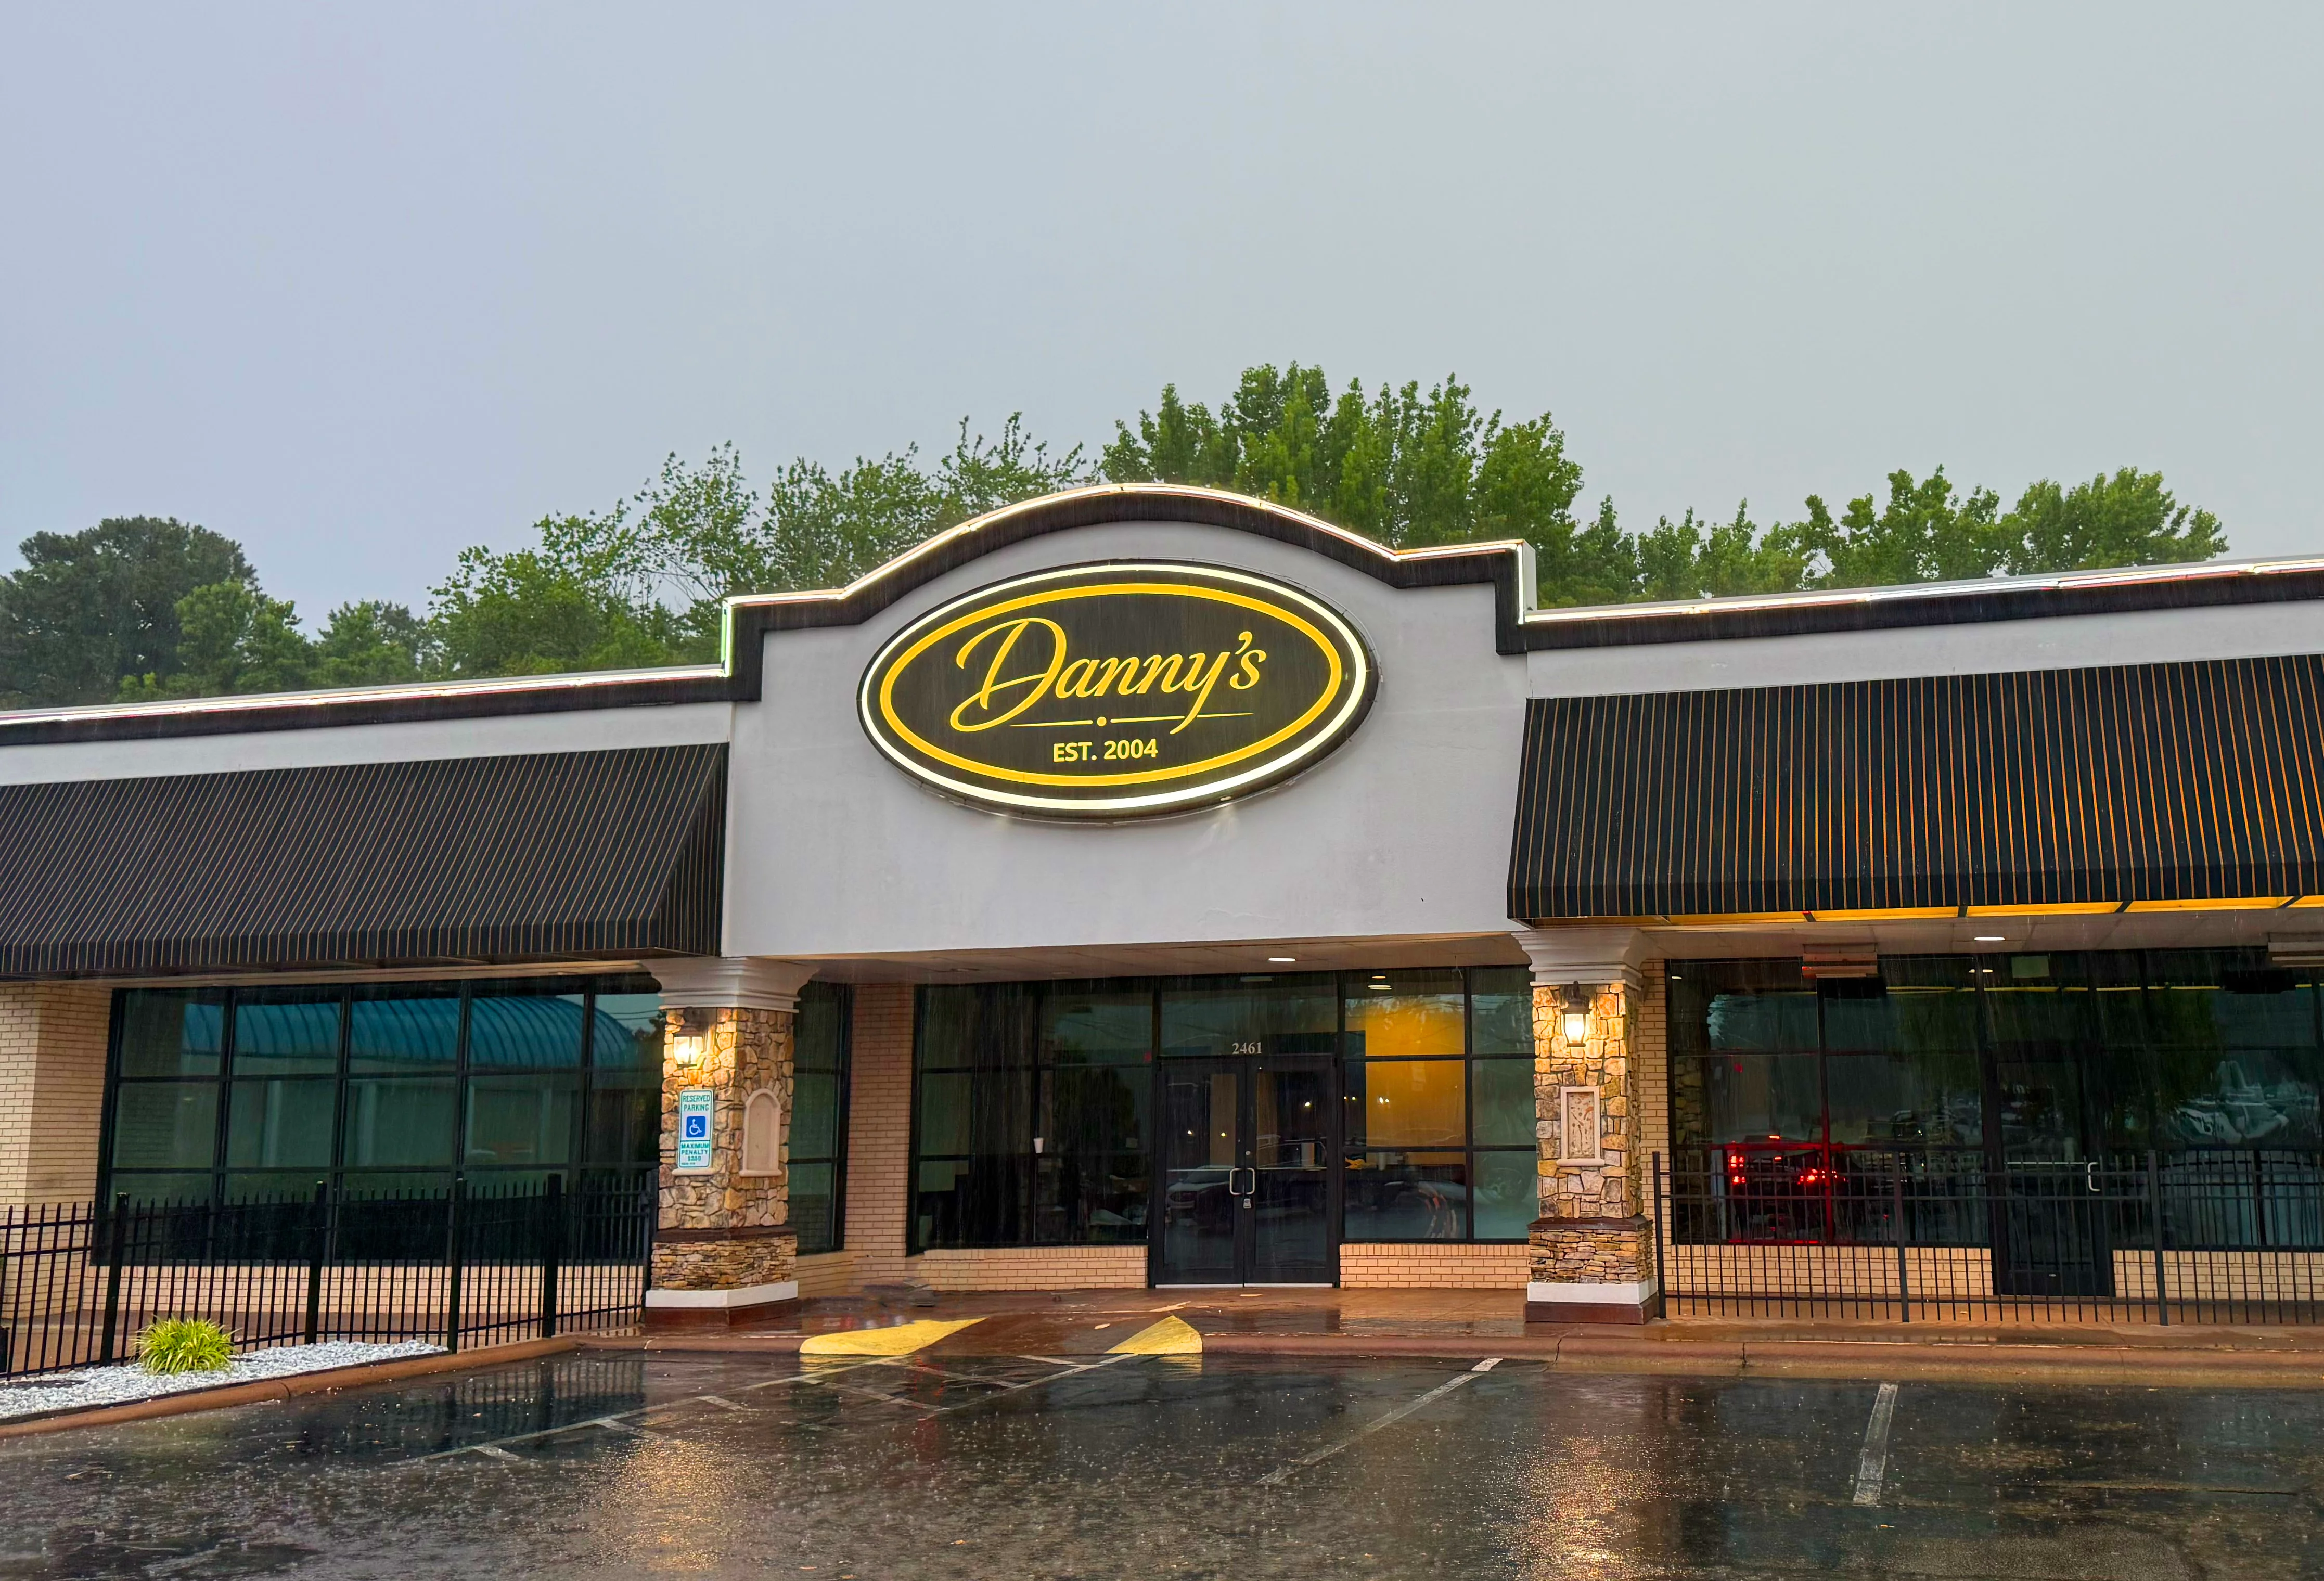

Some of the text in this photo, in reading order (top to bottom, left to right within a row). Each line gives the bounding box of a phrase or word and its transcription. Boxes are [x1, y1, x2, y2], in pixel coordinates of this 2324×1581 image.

[949, 618, 1267, 735] Danny's
[1053, 738, 1158, 762] EST. 2004
[1232, 1042, 1262, 1055] 2461
